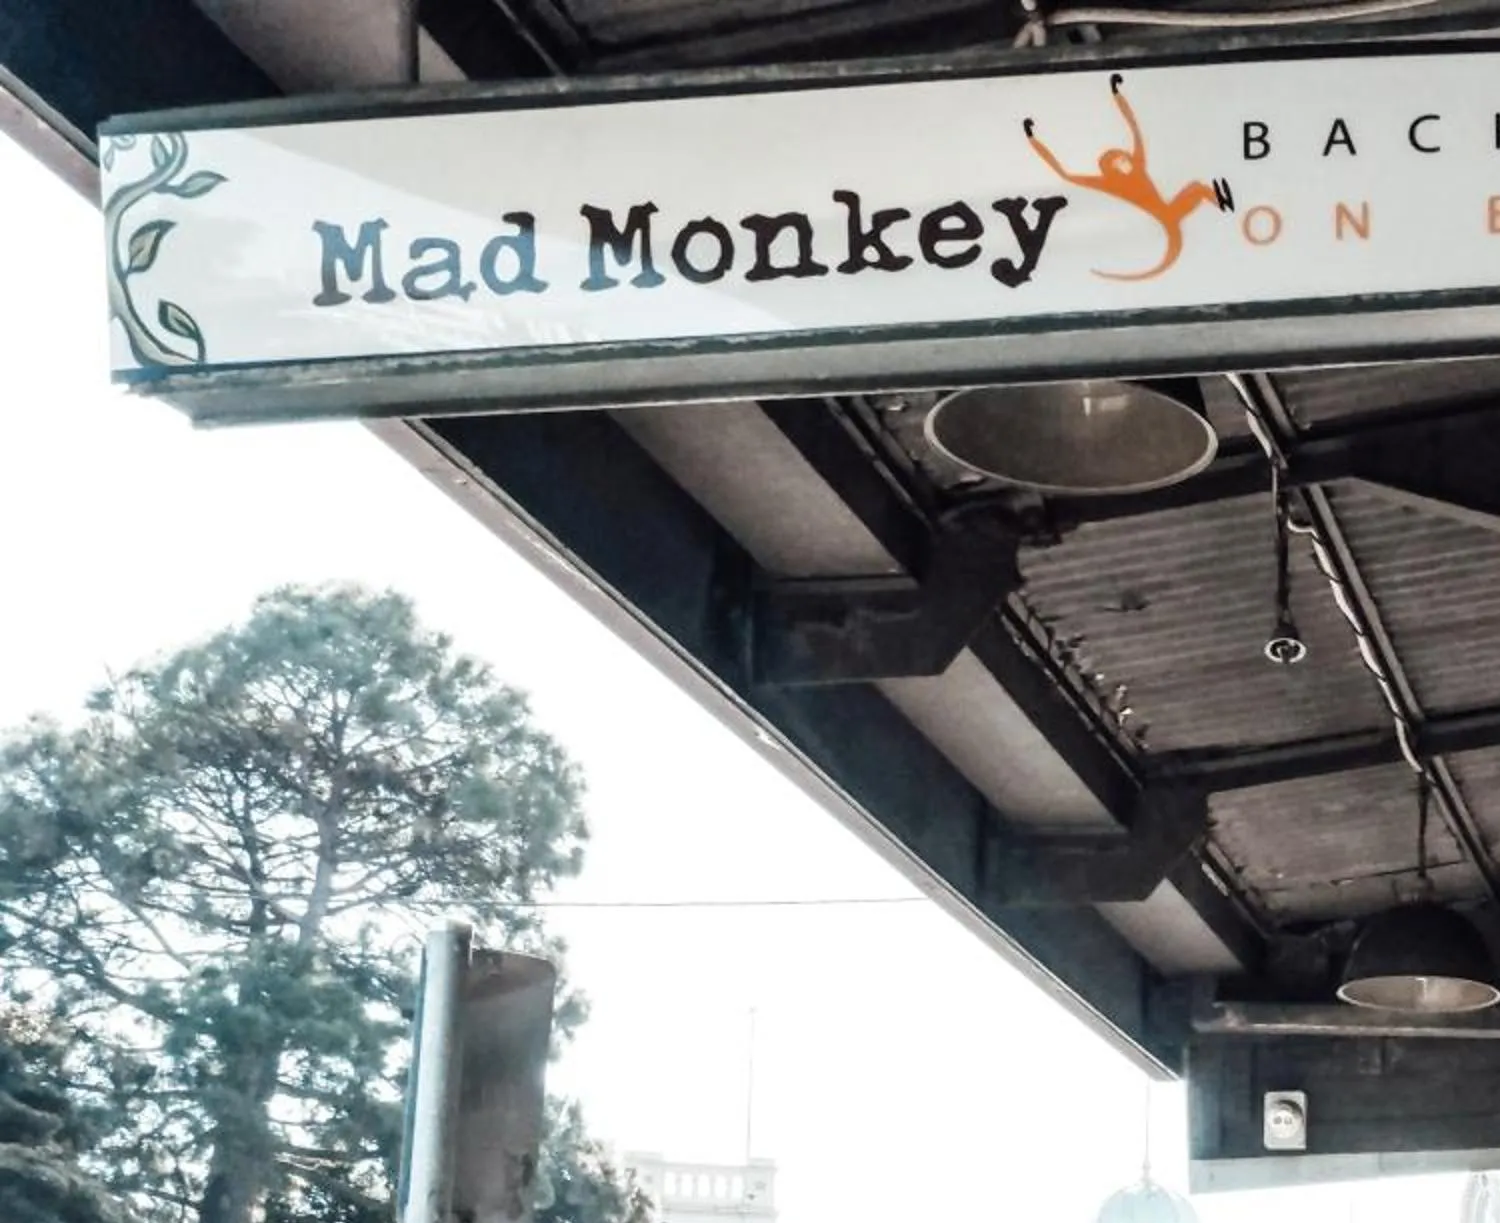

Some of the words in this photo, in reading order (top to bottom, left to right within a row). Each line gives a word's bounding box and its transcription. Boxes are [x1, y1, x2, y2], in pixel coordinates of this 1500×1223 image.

[311, 210, 549, 308] Mad
[578, 188, 1069, 289] Monkey
[1241, 203, 1371, 246] ON
